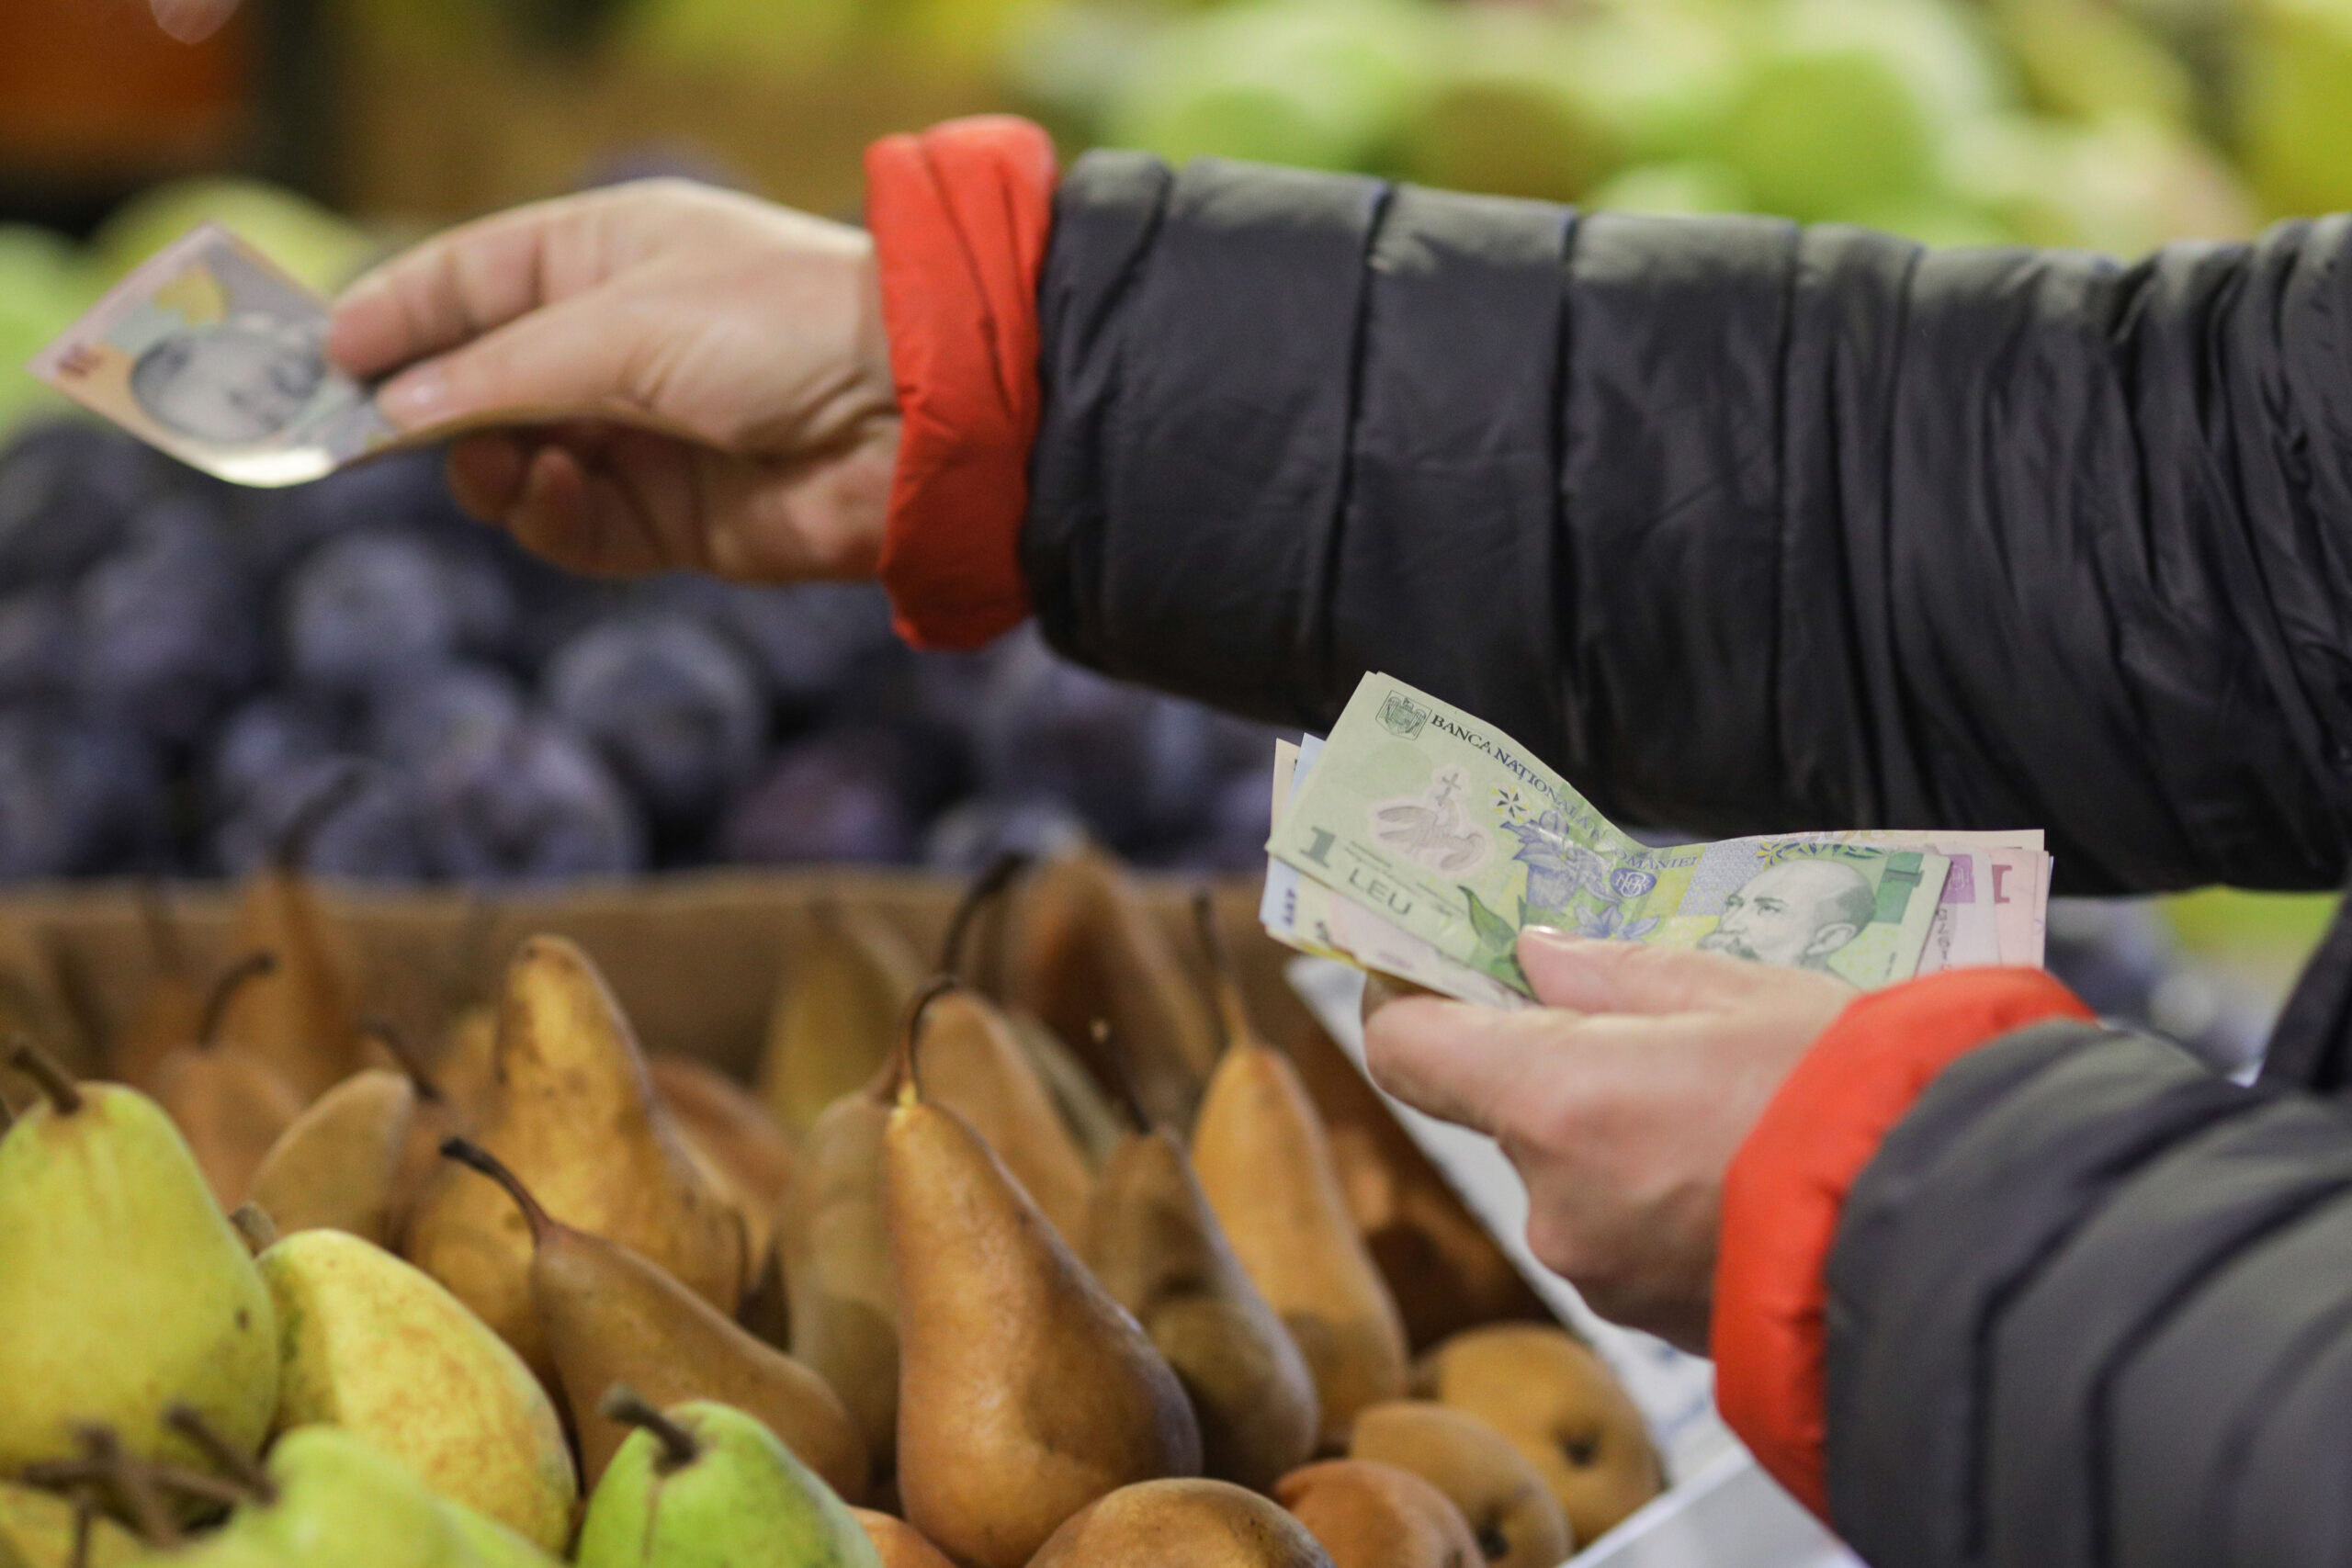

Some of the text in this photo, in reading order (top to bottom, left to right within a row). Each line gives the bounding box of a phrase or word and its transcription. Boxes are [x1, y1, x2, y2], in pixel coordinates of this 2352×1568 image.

[1430, 714, 1492, 755] BANCA
[1298, 826, 1337, 870] 1
[1348, 868, 1413, 916] LEU
